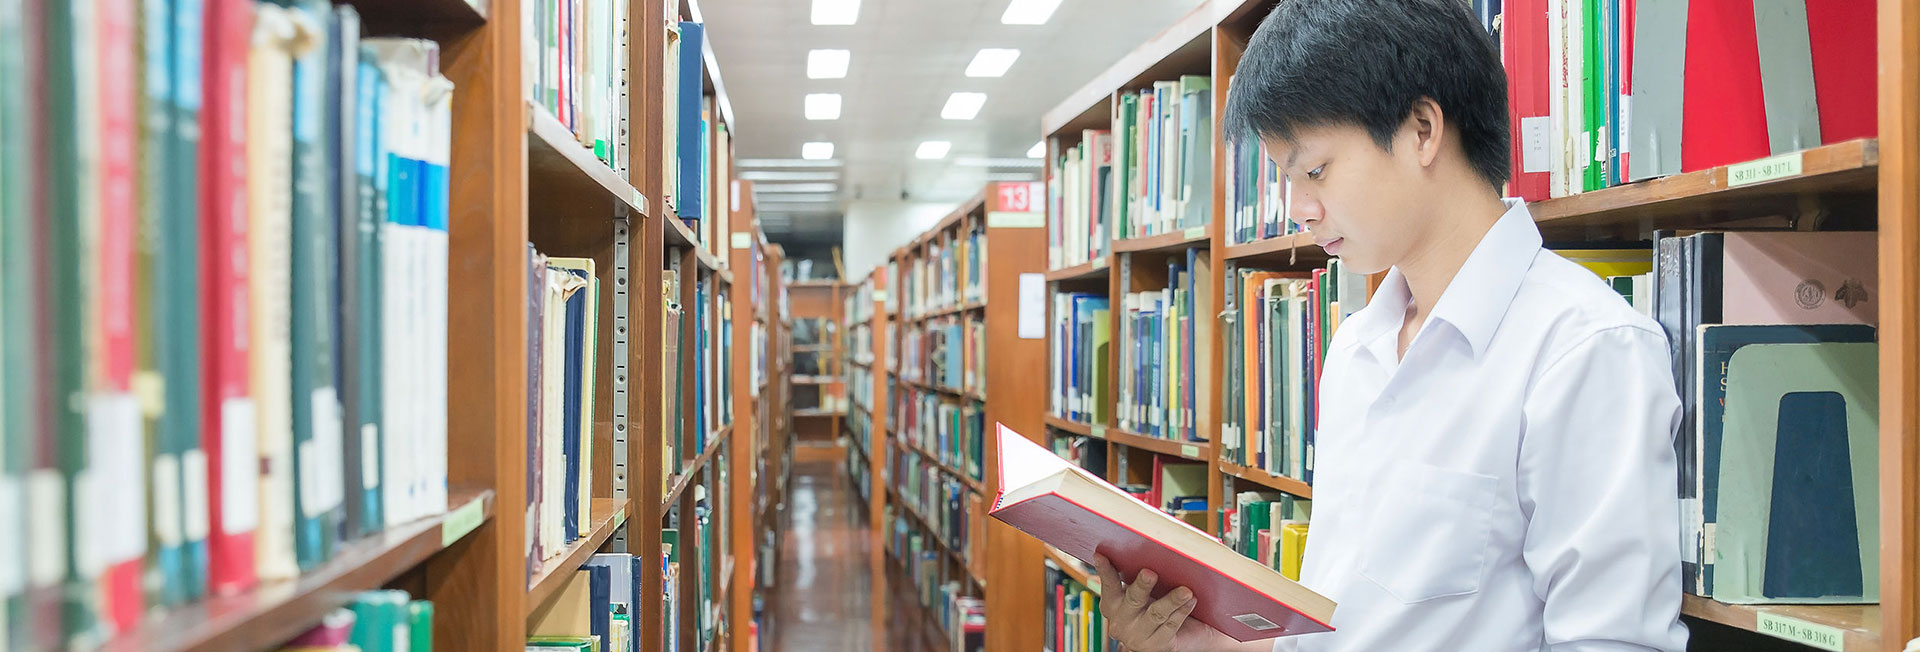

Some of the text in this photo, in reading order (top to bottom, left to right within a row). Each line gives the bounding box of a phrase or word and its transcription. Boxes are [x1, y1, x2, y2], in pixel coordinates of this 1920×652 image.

[1735, 169, 1744, 181] SB
[1762, 165, 1772, 176] SB
[1774, 162, 1786, 175] 317
[1004, 187, 1027, 210] 13
[1763, 619, 1773, 631] SB
[1774, 622, 1786, 633] 317
[1788, 625, 1796, 637] M
[1802, 628, 1813, 641] SB
[1814, 631, 1827, 644] 318
[1828, 634, 1836, 647] G
